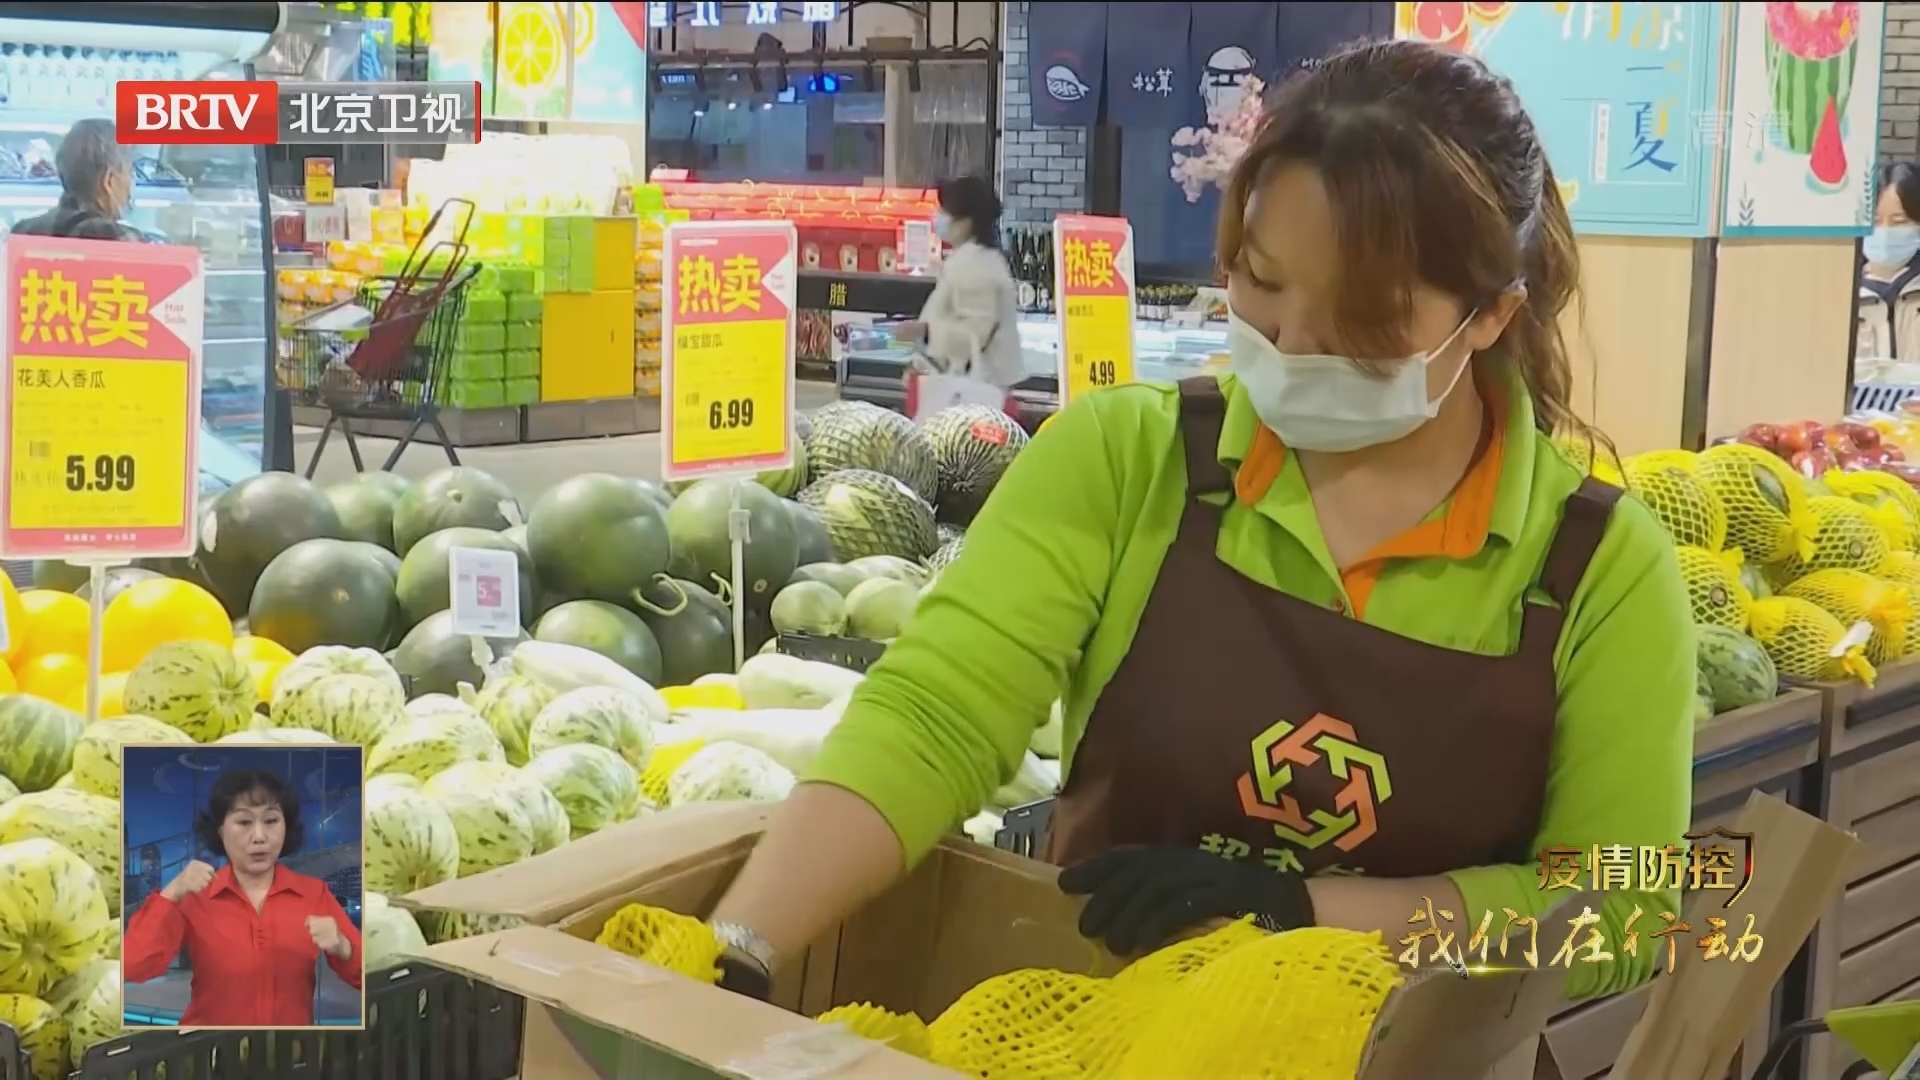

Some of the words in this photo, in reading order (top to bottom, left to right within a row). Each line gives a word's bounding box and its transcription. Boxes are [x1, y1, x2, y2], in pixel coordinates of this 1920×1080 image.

[1064, 238, 1114, 288] 热卖
[678, 253, 762, 315] 热卖
[829, 283, 848, 306] 腊
[20, 269, 150, 349] 热卖
[17, 368, 106, 389] 花美人香瓜
[1089, 361, 1115, 386] 4.99
[709, 398, 754, 430] 6.99
[65, 454, 136, 491] 5.99
